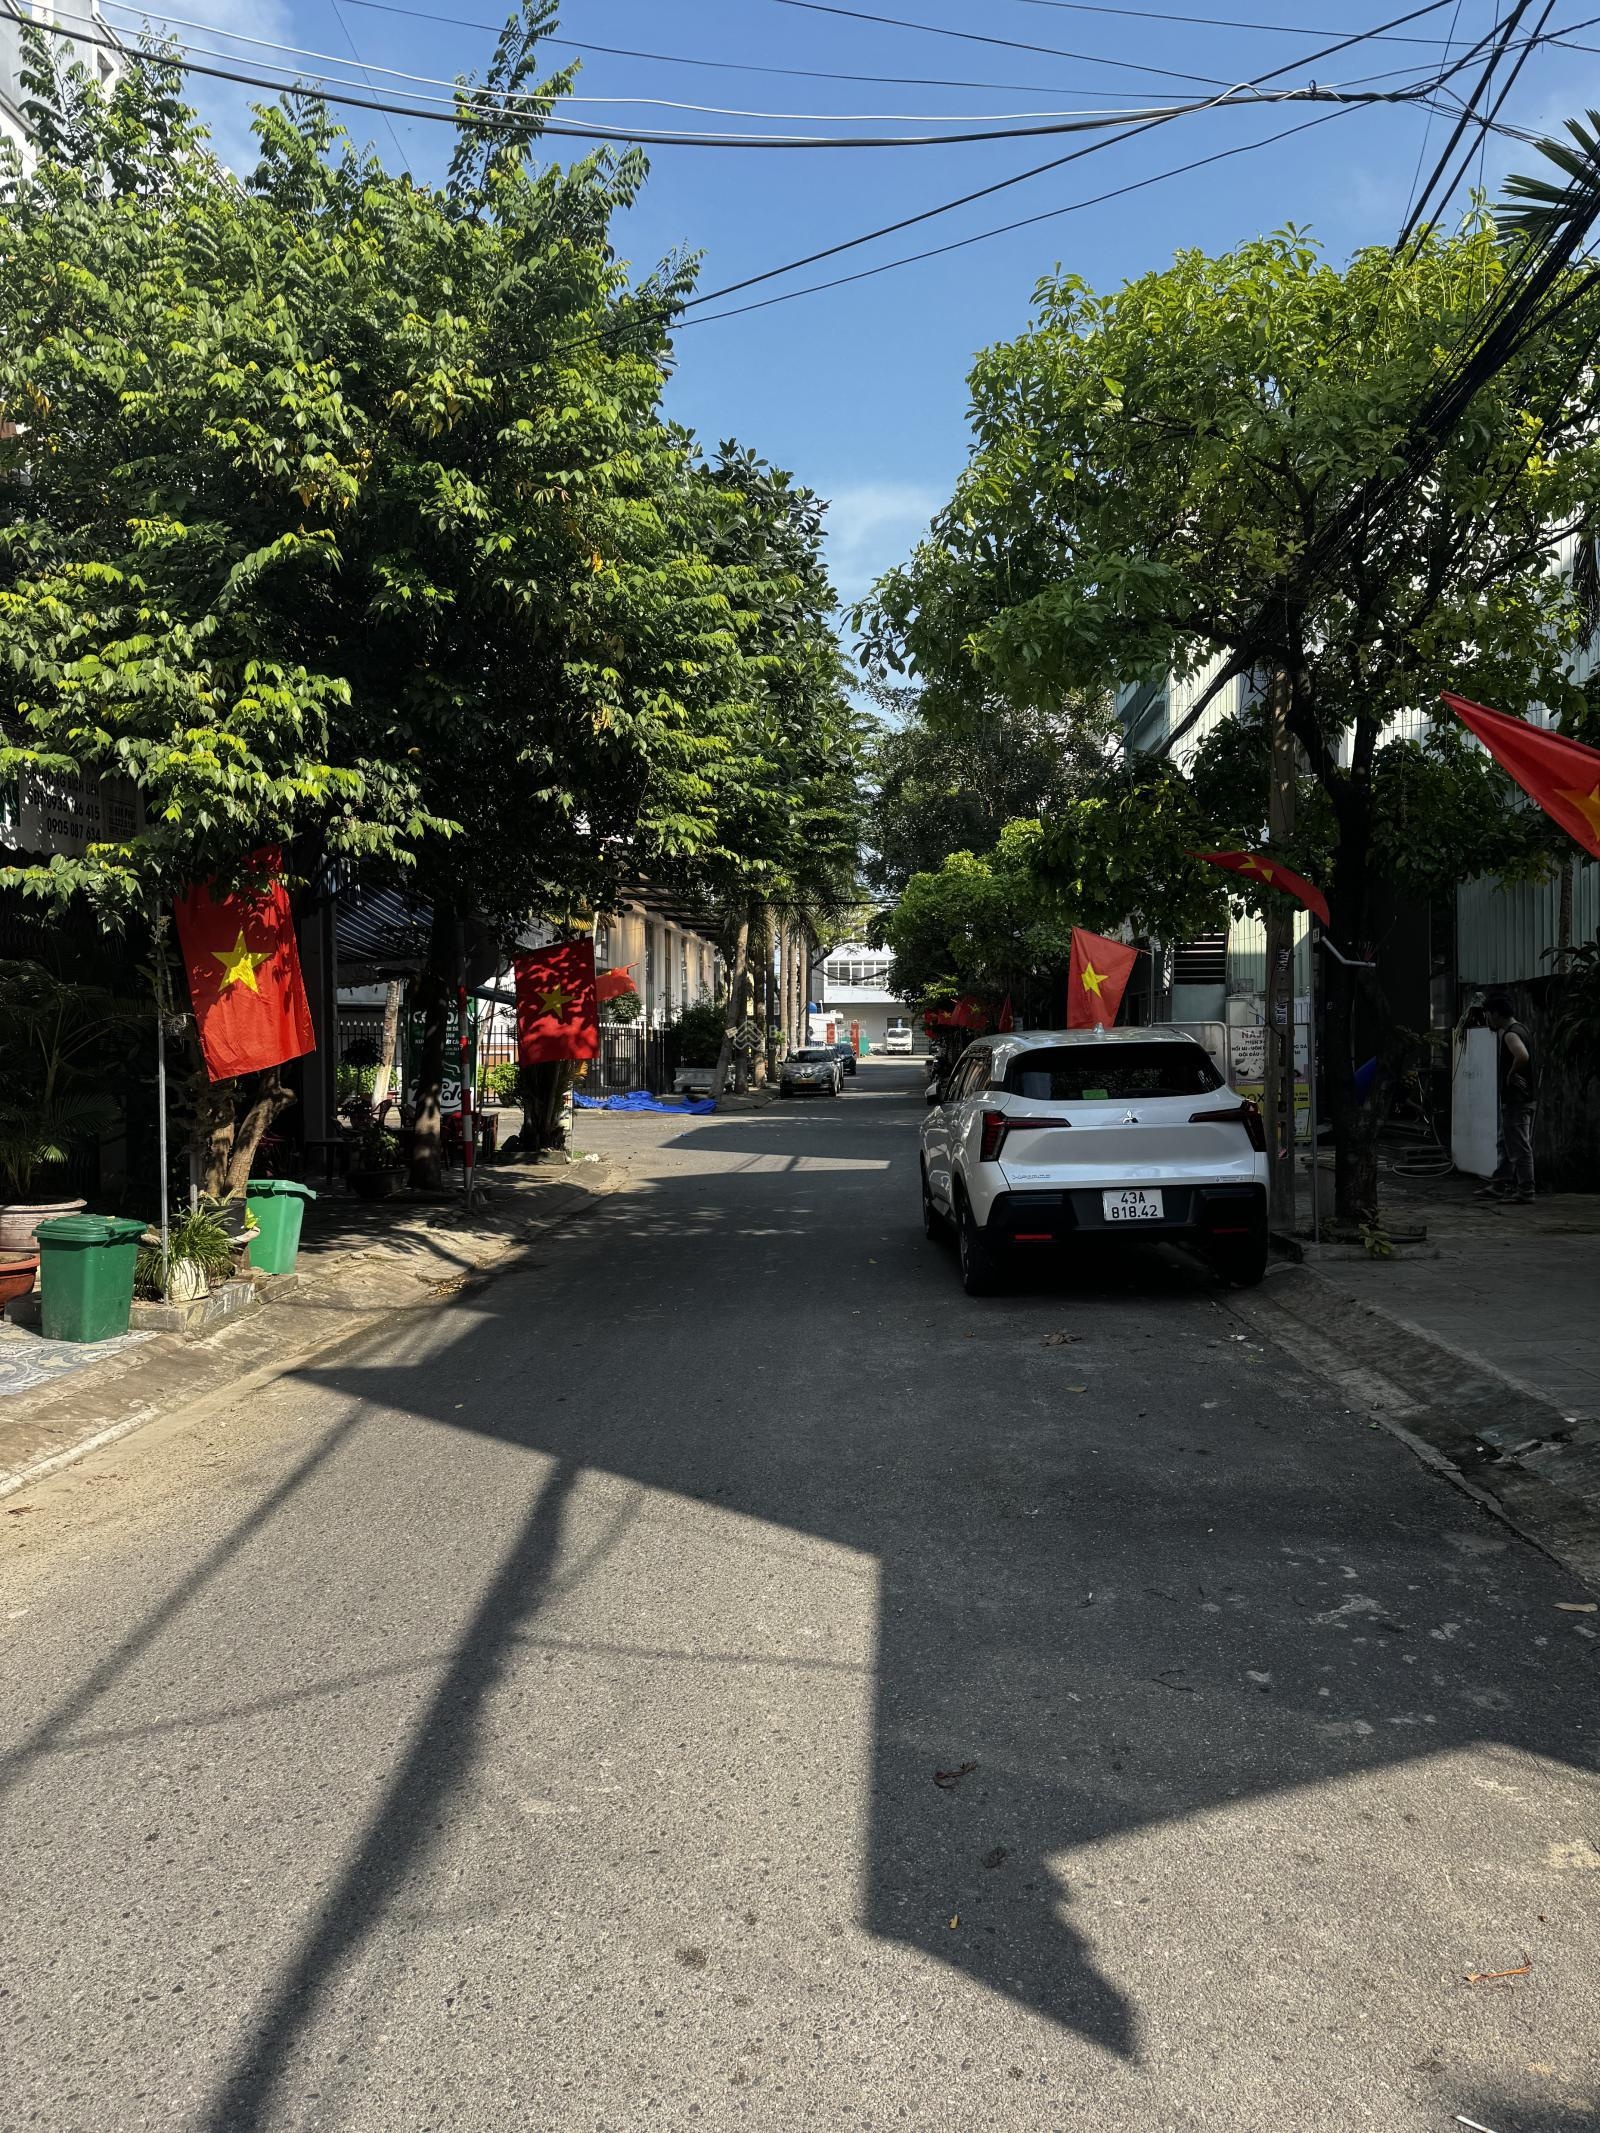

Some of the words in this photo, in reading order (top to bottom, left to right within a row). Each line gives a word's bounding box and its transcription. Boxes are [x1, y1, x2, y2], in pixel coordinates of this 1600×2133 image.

[85, 803, 100, 820] 415
[47, 817, 69, 835] 0905
[70, 822, 84, 838] 087
[1120, 1191, 1146, 1205] 43A
[1111, 1204, 1158, 1219] 818.42
